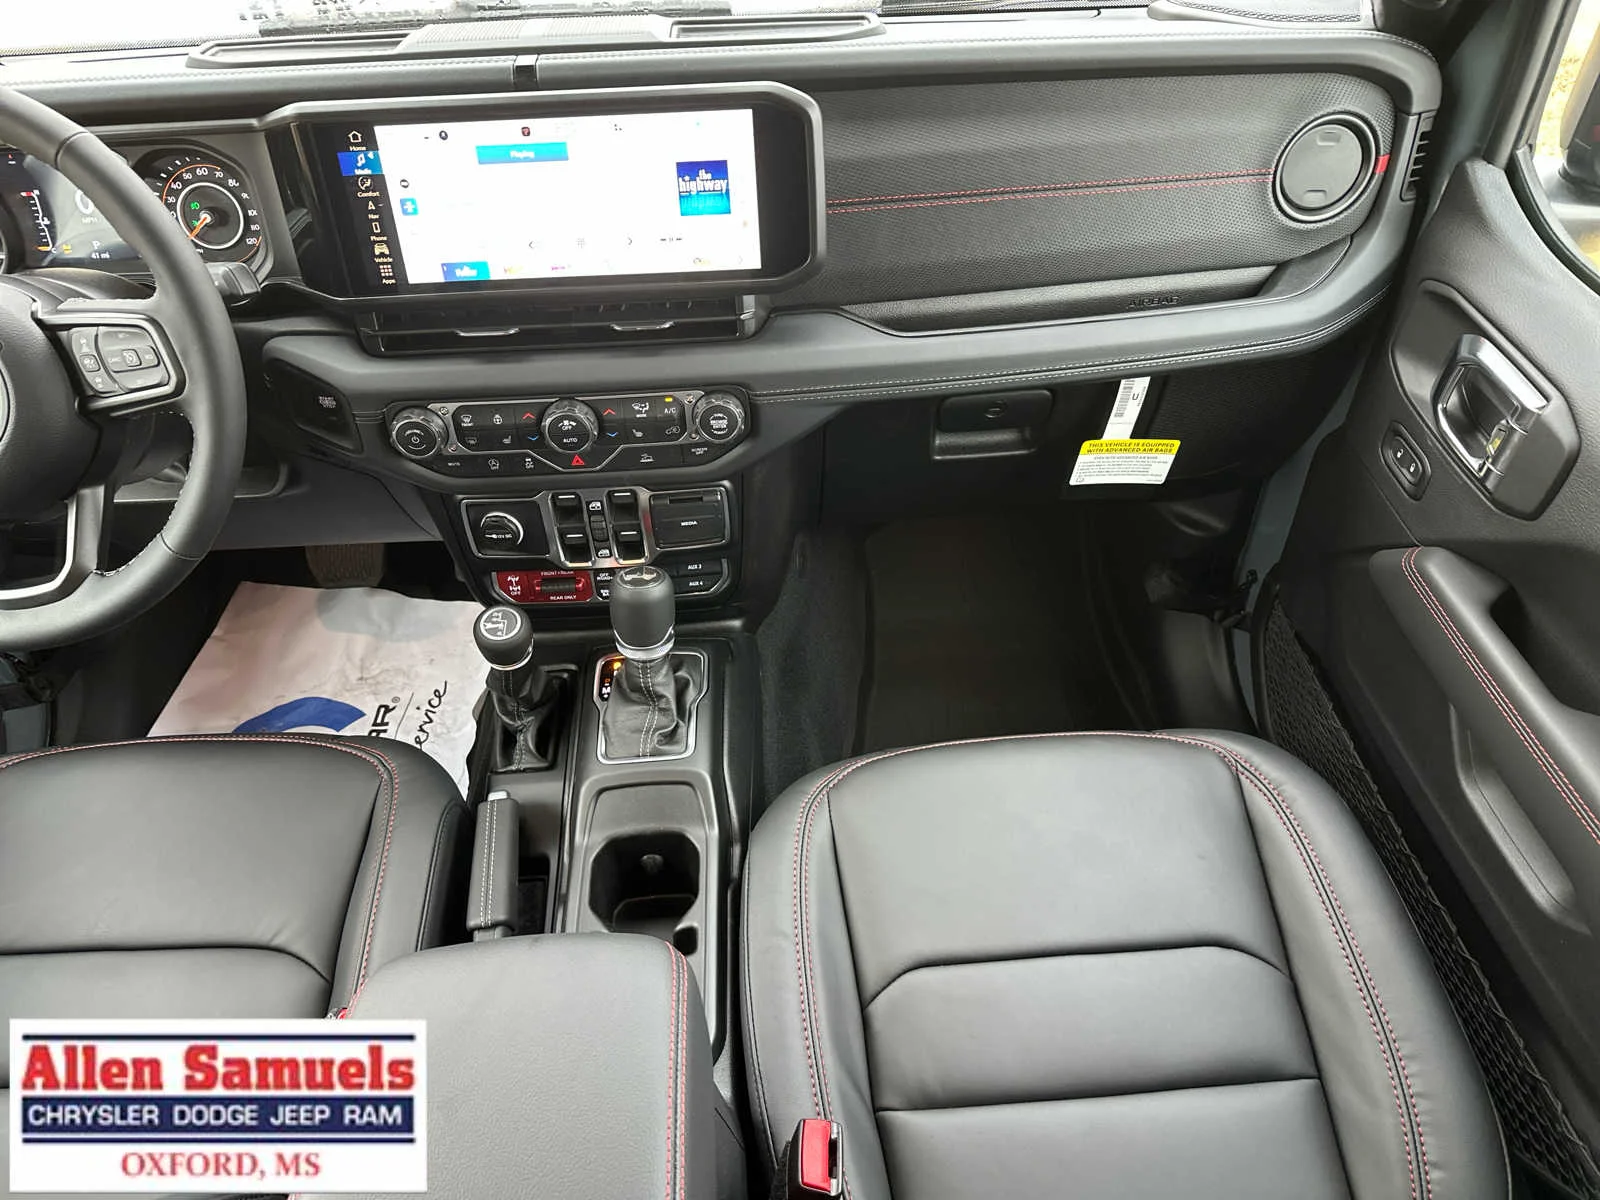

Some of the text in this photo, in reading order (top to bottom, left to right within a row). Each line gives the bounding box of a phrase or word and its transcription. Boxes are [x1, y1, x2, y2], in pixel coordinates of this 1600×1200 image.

[196, 167, 208, 176] 60
[699, 169, 712, 180] the
[171, 182, 182, 190] 40
[678, 175, 728, 195] highway
[602, 686, 610, 694] M
